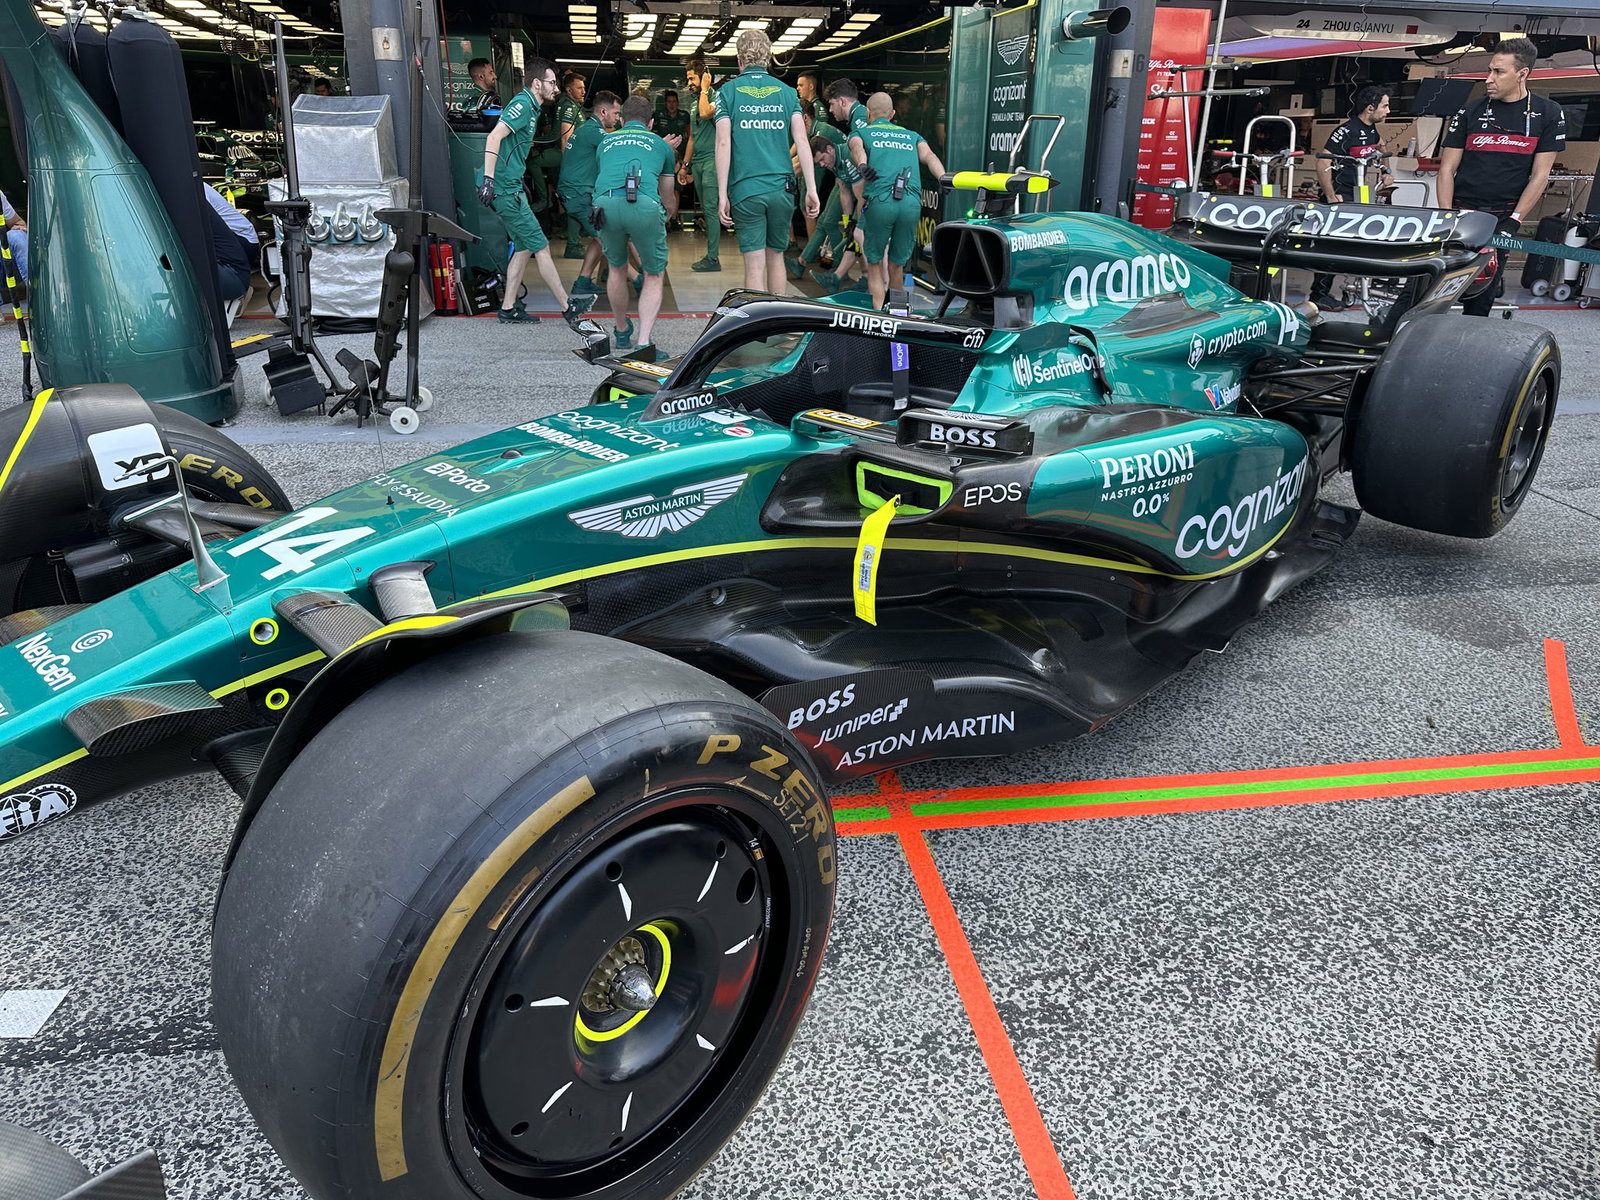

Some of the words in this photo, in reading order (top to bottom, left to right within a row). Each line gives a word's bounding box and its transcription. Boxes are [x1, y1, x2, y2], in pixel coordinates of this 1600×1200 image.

[1296, 19, 1310, 29] 24
[1322, 20, 1351, 31] ZHOU
[1353, 22, 1395, 33] GUANYU
[993, 81, 1026, 107] cognizant
[739, 104, 784, 115] cognizant
[740, 119, 785, 130] aramco
[870, 131, 911, 140] cognizant
[603, 133, 655, 145] cognizant
[603, 139, 653, 153] aramco
[872, 140, 914, 151] aramco
[1011, 230, 1066, 253] BOMBARDIER
[1492, 237, 1523, 250] MARTIN
[1064, 253, 1191, 310] aramco
[863, 330, 895, 338] NETWORKS
[1262, 300, 1299, 346] 14
[963, 328, 985, 348] citi
[1208, 319, 1268, 355] crypto.com
[661, 393, 714, 415] aramco
[515, 422, 630, 463] BOMBARDIER
[558, 411, 680, 452] cognizant
[930, 423, 997, 448] BOSS
[171, 449, 272, 509] ERO
[1098, 443, 1195, 489] PERONI
[369, 473, 401, 487] FLY
[1101, 485, 1144, 502] NASTRO
[1147, 472, 1193, 492] AZZURRO
[624, 503, 660, 521] ASTON
[661, 493, 702, 511] MARTIN
[1133, 492, 1170, 518] 0.0%
[1175, 454, 1308, 558] cognizan
[226, 507, 376, 580] 14
[15, 632, 77, 691] NexGen
[788, 683, 856, 730] BOSS
[835, 729, 916, 771] ASTON
[921, 711, 1016, 745] MARTIN
[697, 734, 742, 765] P
[750, 744, 836, 886] ZERO
